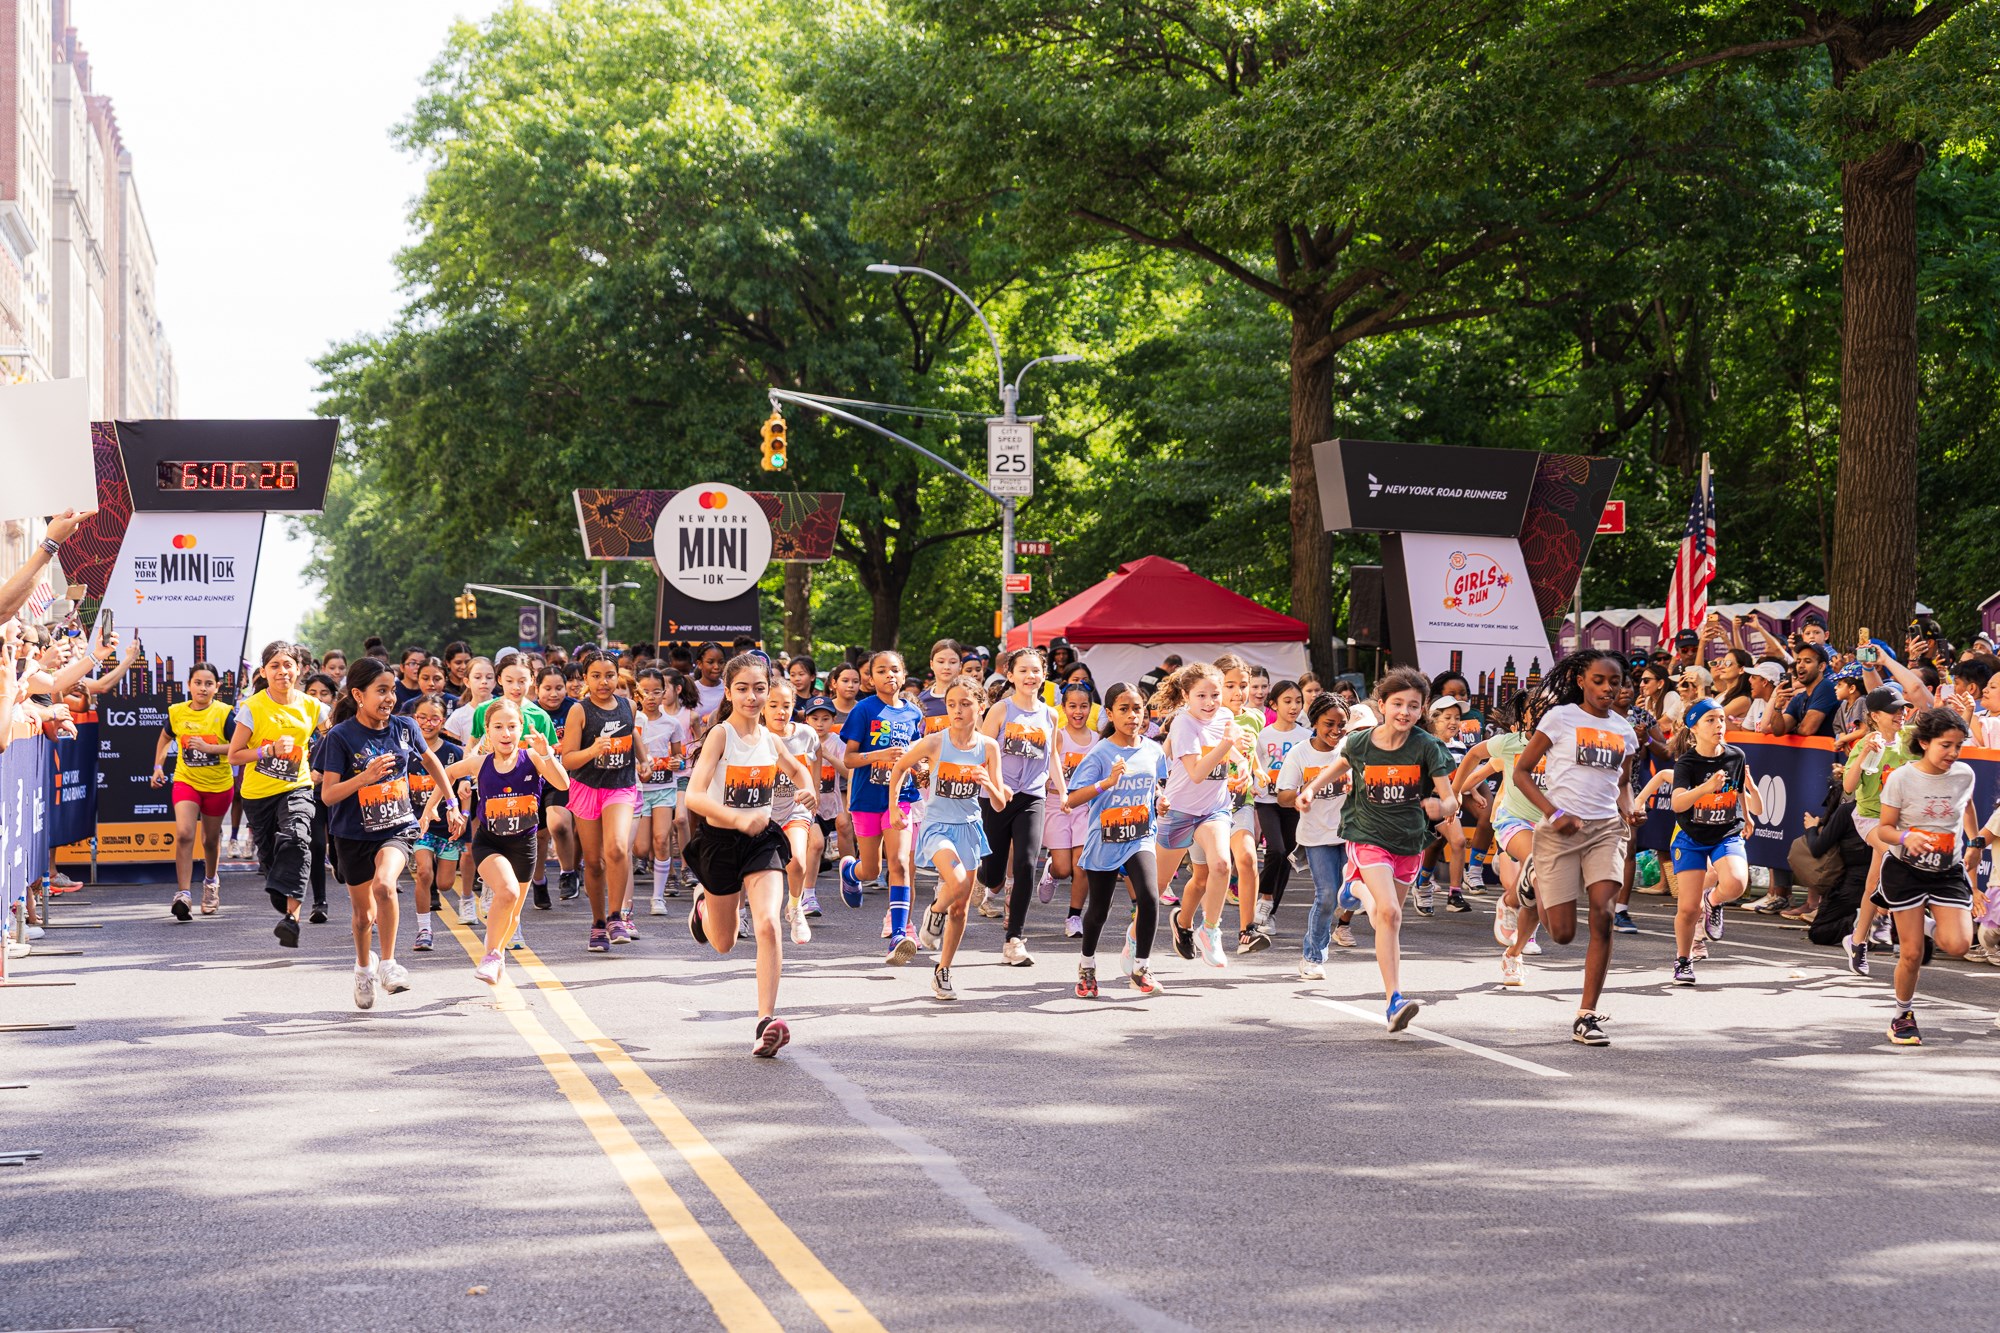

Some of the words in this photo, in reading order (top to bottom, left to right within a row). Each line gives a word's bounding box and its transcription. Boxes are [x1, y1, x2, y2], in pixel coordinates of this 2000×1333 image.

[996, 454, 1026, 472] 25
[1385, 485, 1408, 494] NEW
[1409, 486, 1435, 496] YORK
[1436, 488, 1461, 498] ROAD
[1464, 489, 1508, 500] RUNNERS
[679, 515, 705, 523] NEW
[714, 515, 747, 523] YORK
[679, 528, 747, 572] MINI
[135, 561, 157, 569] NEW
[161, 554, 209, 584] MINI
[1454, 566, 1497, 595] GIRLS
[1468, 588, 1488, 606] RUN
[107, 708, 136, 726] tcs
[604, 721, 620, 732] NIKE
[870, 720, 891, 734] PS
[870, 732, 889, 746] 75
[1021, 741, 1031, 753] 76
[609, 753, 624, 766] 334
[1596, 748, 1612, 763] 777
[270, 758, 289, 771] 953
[747, 789, 759, 803] 79
[950, 783, 973, 796] 1038
[1383, 785, 1405, 799] 802
[134, 804, 168, 814] ESPN
[380, 801, 399, 818] 954
[1710, 809, 1726, 821] 222
[508, 817, 520, 830] 37
[1119, 825, 1136, 838] 310
[1755, 828, 1783, 840] mastercard
[1918, 851, 1941, 866] 348
